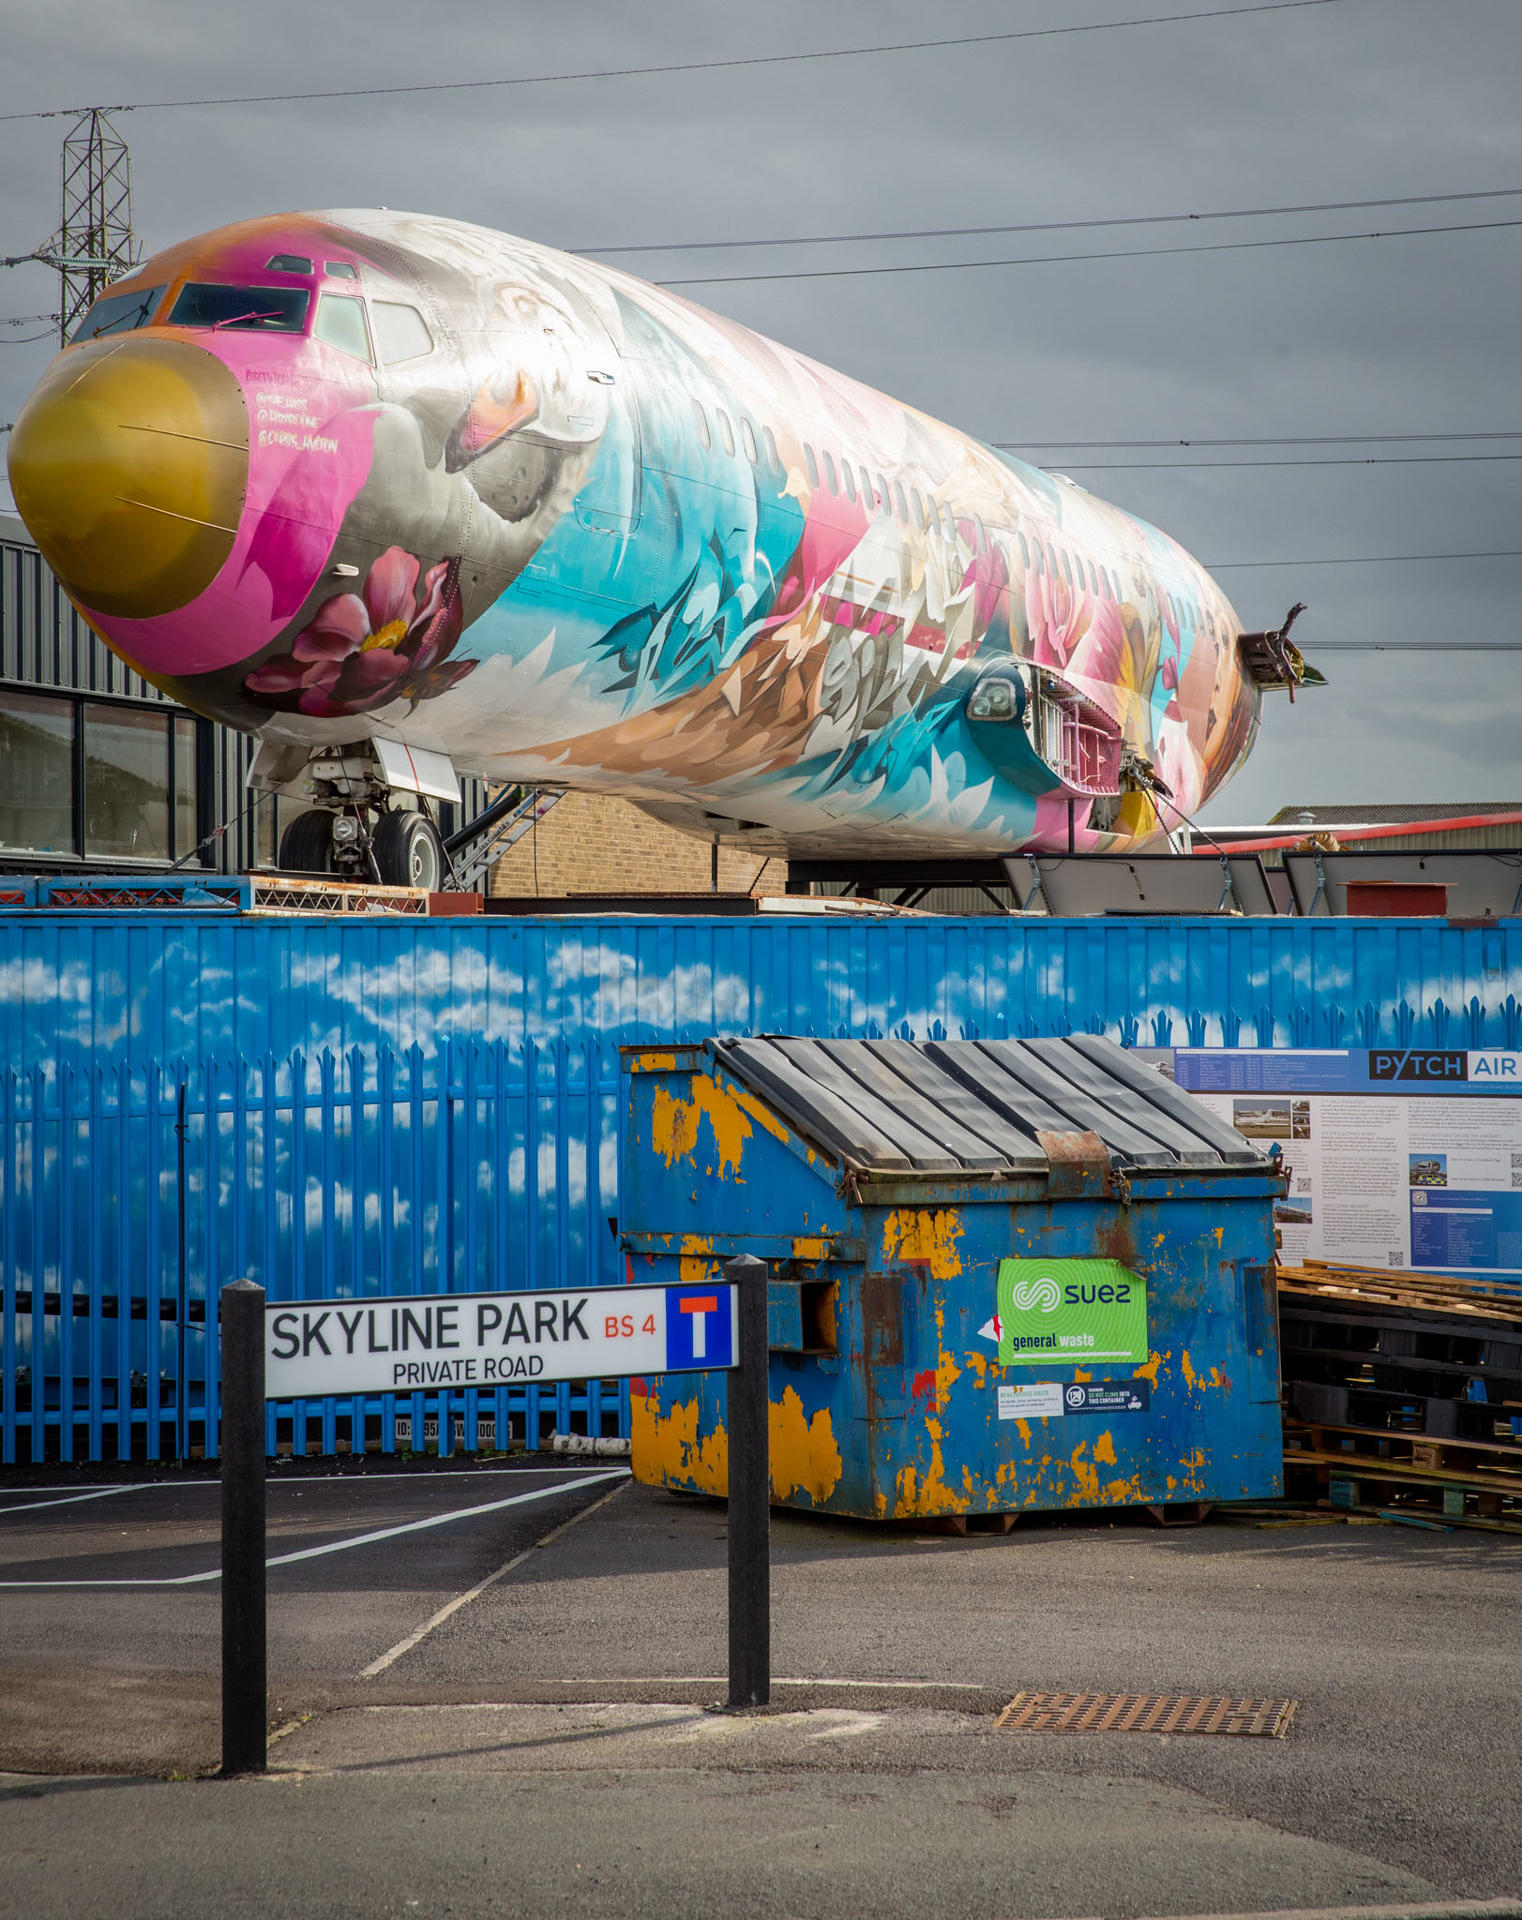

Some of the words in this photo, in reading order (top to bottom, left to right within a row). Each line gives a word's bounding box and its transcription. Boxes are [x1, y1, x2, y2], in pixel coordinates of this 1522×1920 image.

[1376, 1050, 1460, 1080] PYTCH
[1474, 1057, 1517, 1075] AIR
[1064, 1284, 1131, 1304] suez
[271, 1306, 459, 1359] SKYLINE
[478, 1299, 590, 1346] PARK
[605, 1315, 634, 1338] BS
[641, 1314, 656, 1335] 4
[1013, 1333, 1057, 1351] general
[1059, 1333, 1095, 1347] waste
[394, 1359, 477, 1385] PRIVATE
[485, 1355, 544, 1379] ROAD
